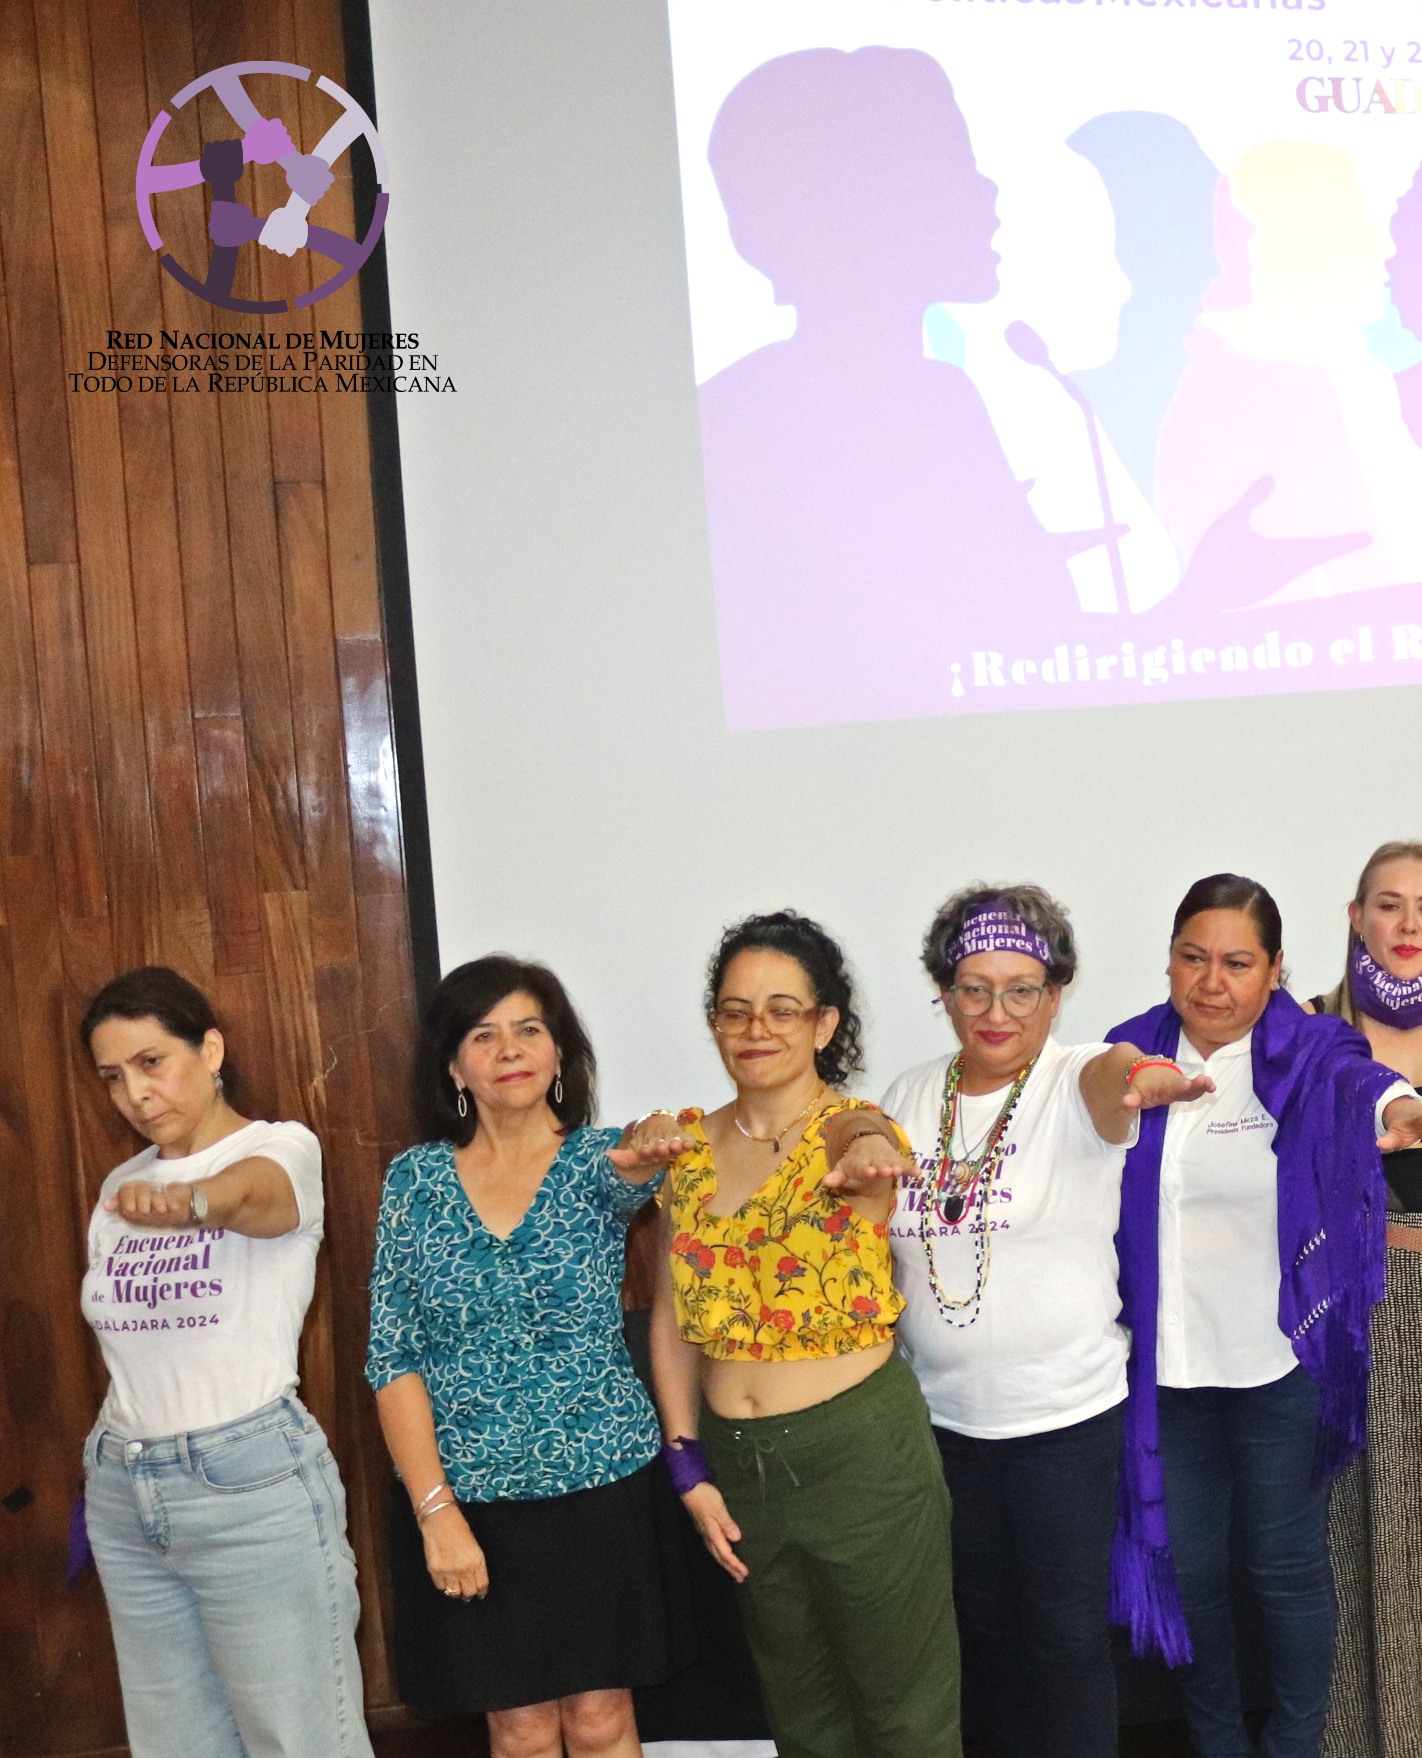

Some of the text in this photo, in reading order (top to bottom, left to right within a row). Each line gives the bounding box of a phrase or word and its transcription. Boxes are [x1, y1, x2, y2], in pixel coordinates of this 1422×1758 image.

[1287, 38, 1333, 65] 20,
[1342, 39, 1370, 63] 21
[1380, 44, 1397, 69] y
[950, 631, 1313, 698] ¡Redirigiendo
[1330, 626, 1373, 665] el
[964, 935, 1033, 955] Mujeres
[98, 1244, 211, 1277] Nacional
[91, 1276, 223, 1310] de Mujeres
[176, 1314, 220, 1329] 2024
